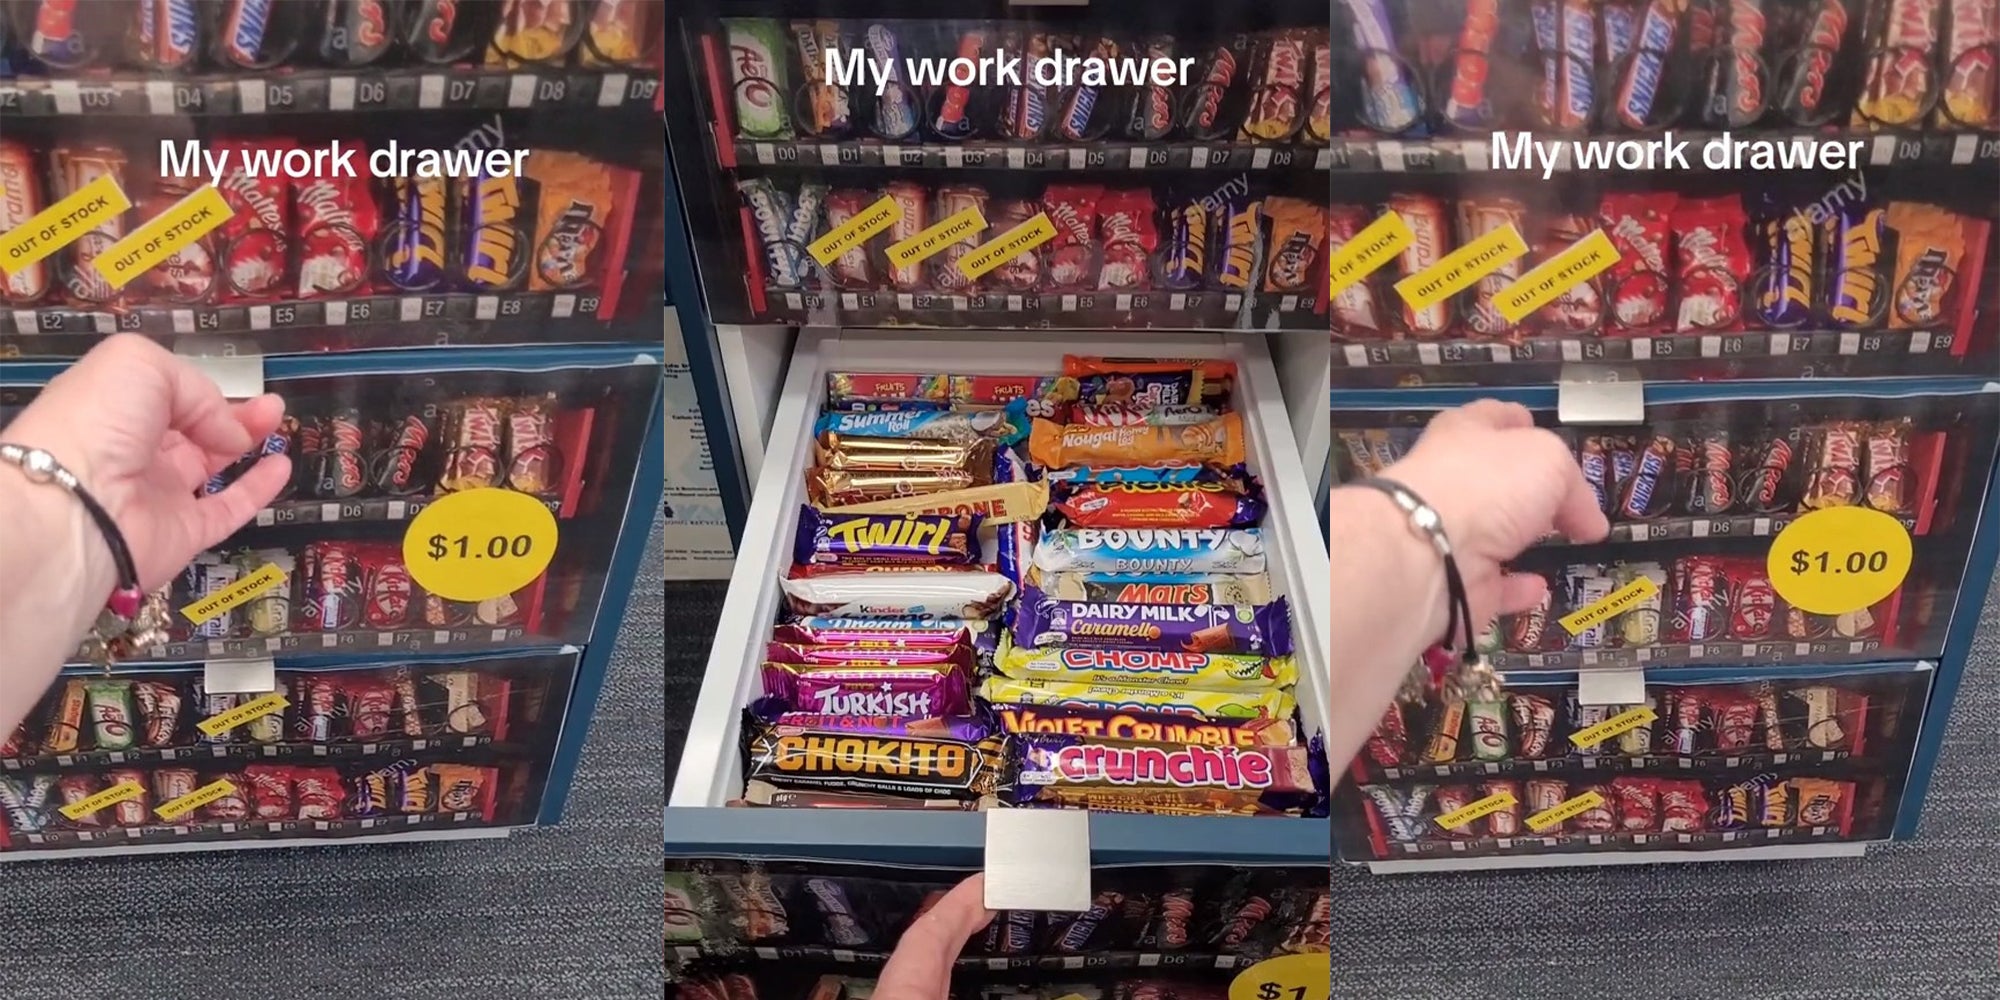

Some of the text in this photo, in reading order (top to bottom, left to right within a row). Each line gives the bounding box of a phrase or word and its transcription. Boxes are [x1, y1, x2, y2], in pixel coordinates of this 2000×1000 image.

[269, 85, 293, 105] D5
[360, 82, 385, 102] D6
[450, 80, 475, 100] D7
[540, 80, 565, 100] D8
[630, 80, 657, 99] D9
[177, 88, 201, 107] D4
[1900, 142, 1921, 159] D8
[1980, 141, 2000, 158] D9
[1027, 152, 1043, 164] D4
[1088, 151, 1104, 164] D5
[1151, 151, 1167, 164] D6
[1212, 151, 1229, 163] D7
[1274, 151, 1291, 164] D8
[9, 195, 109, 259] OUT OF STOCK
[823, 208, 891, 255] OUT OF STOCK
[114, 205, 214, 272] OUT OF STOCK
[900, 218, 973, 260] OUT OF STOCK
[971, 227, 1043, 270] OUT OF STOCK
[1338, 259, 1356, 276] OF
[1356, 231, 1398, 263] STOCK
[1417, 241, 1509, 298] OUT OF STOCK
[1511, 250, 1601, 309] OUT OF STOCK
[425, 301, 445, 315] E7
[502, 301, 521, 314] E8
[579, 298, 598, 312] E9
[862, 296, 875, 306] E1
[916, 296, 930, 307] E2
[971, 298, 985, 308] E3
[1026, 298, 1039, 309] E4
[1080, 297, 1093, 307] E5
[1134, 297, 1148, 308] E6
[1188, 296, 1201, 307] E7
[1301, 298, 1315, 308] E9
[276, 308, 294, 323] E5
[351, 304, 370, 318] E6
[42, 314, 63, 329] E2
[121, 314, 141, 329] E3
[200, 313, 218, 328] E4
[1656, 341, 1673, 354] E5
[1725, 339, 1742, 352] E6
[1793, 338, 1810, 351] E7
[1863, 337, 1880, 350] E8
[1934, 335, 1951, 348] E9
[1373, 349, 1390, 362] E1
[1445, 348, 1462, 360] E2
[1586, 344, 1604, 357] E4
[875, 382, 906, 392] FRUITS
[994, 385, 1024, 395] FRUITS
[839, 409, 926, 432] Summer
[888, 418, 911, 433] Roll
[1063, 429, 1120, 448] Nougat
[277, 509, 294, 521] D5
[343, 505, 361, 517] D6
[828, 512, 951, 555] Twirl
[1651, 525, 1668, 537] D5
[1712, 521, 1730, 533] D6
[1078, 529, 1228, 550] BOUNTY
[427, 533, 533, 561] $1.00
[1115, 557, 1193, 572] BOUNTY
[1790, 549, 1889, 576] $1.00
[197, 574, 273, 616] OUT OF STOCK
[1116, 583, 1210, 604] Mars
[1071, 603, 1195, 622] DAIRY MILK
[1574, 587, 1645, 627] OUT OF STOCK
[340, 635, 354, 644] F6
[397, 634, 409, 643] F7
[453, 632, 466, 641] F8
[509, 629, 522, 638] F9
[1706, 646, 1720, 655] F6
[1759, 645, 1772, 654] F7
[1813, 643, 1826, 652] F8
[1866, 641, 1879, 650] F9
[1063, 649, 1209, 673] CHOMP
[1116, 676, 1156, 684] Monster
[814, 684, 932, 716] TURKISH
[211, 701, 277, 730] OUT OF STOCK
[777, 714, 837, 728] FRUIT
[1000, 709, 1257, 747] VIOLET CRUMBLE
[1583, 713, 1645, 742] OUT OF STOCK
[775, 736, 964, 777] CHOKITO
[1056, 744, 1273, 789] crunchie
[1164, 955, 1184, 965] D6
